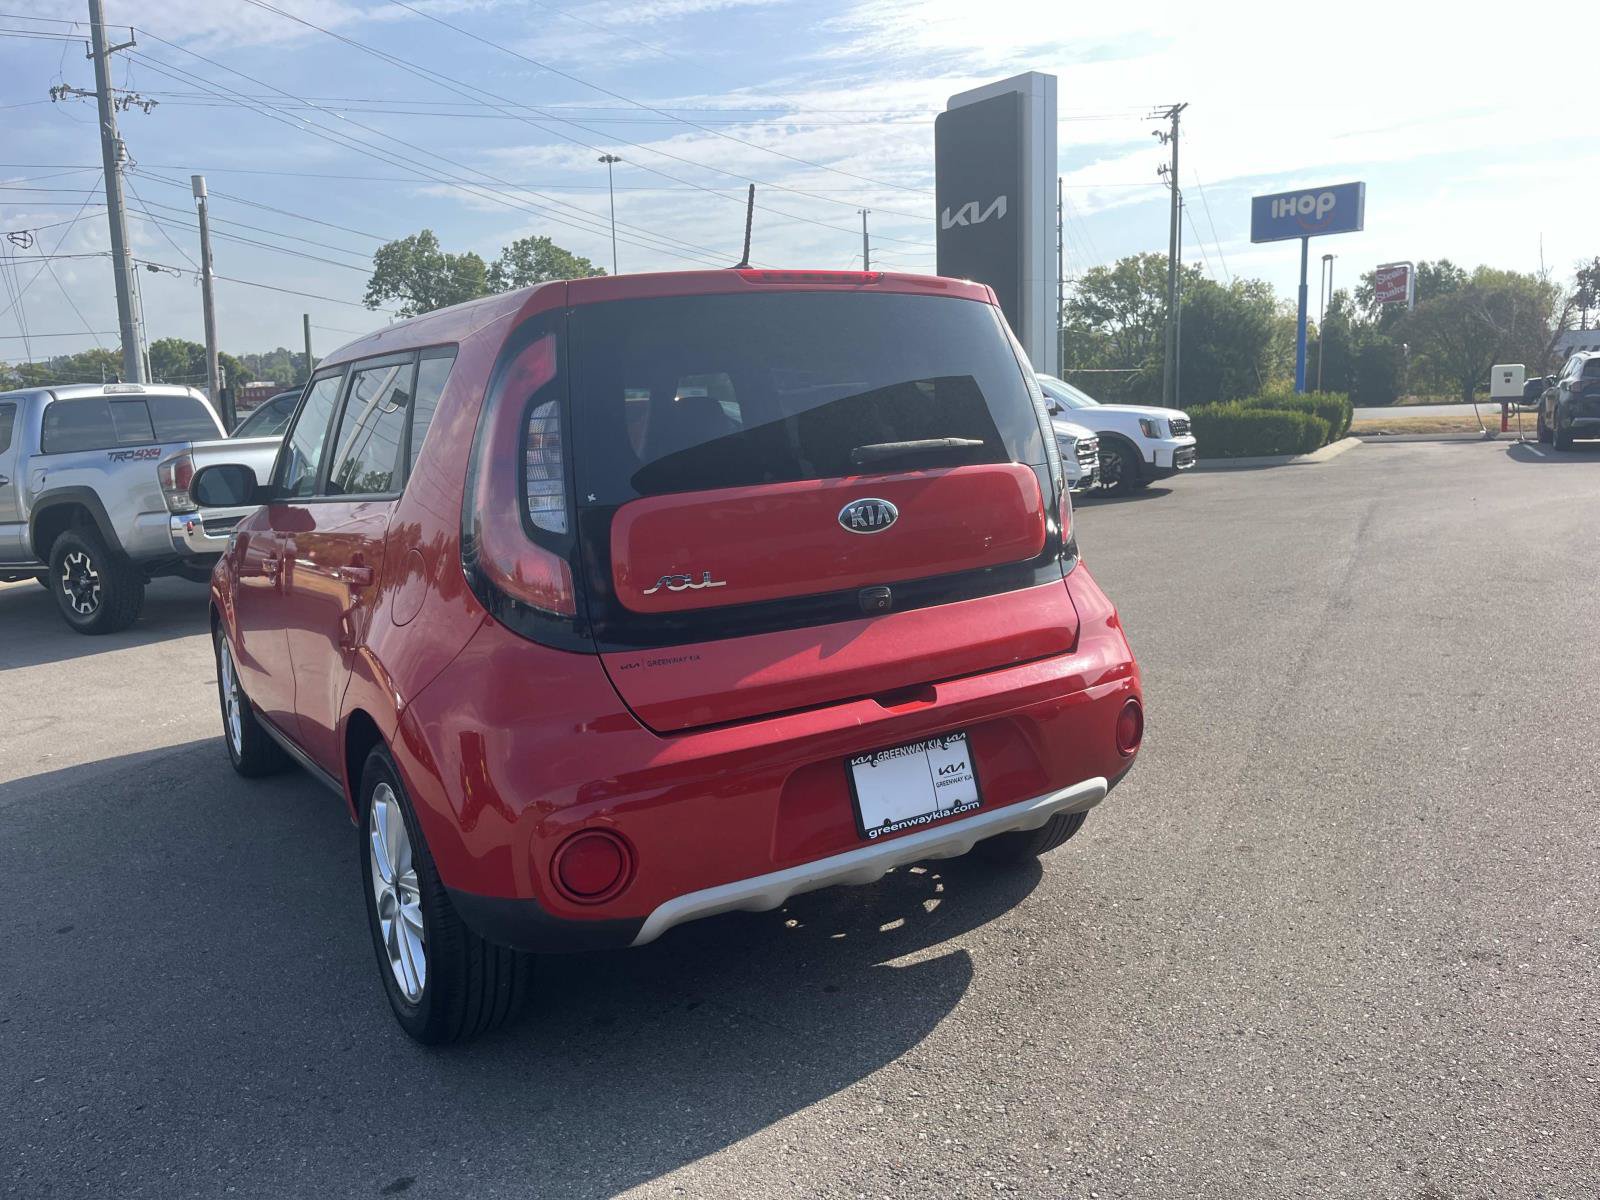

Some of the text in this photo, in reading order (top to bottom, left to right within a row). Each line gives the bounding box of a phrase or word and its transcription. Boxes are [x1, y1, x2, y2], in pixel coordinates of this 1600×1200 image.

[941, 195, 1007, 230] KIA
[1271, 192, 1336, 220] IHOP
[849, 504, 891, 527] KIA
[877, 742, 926, 762] GREENWAY
[927, 739, 943, 750] KIA
[938, 761, 965, 776] KIA
[936, 776, 963, 788] GREENWAY
[868, 801, 980, 839] greenwaykia.com
